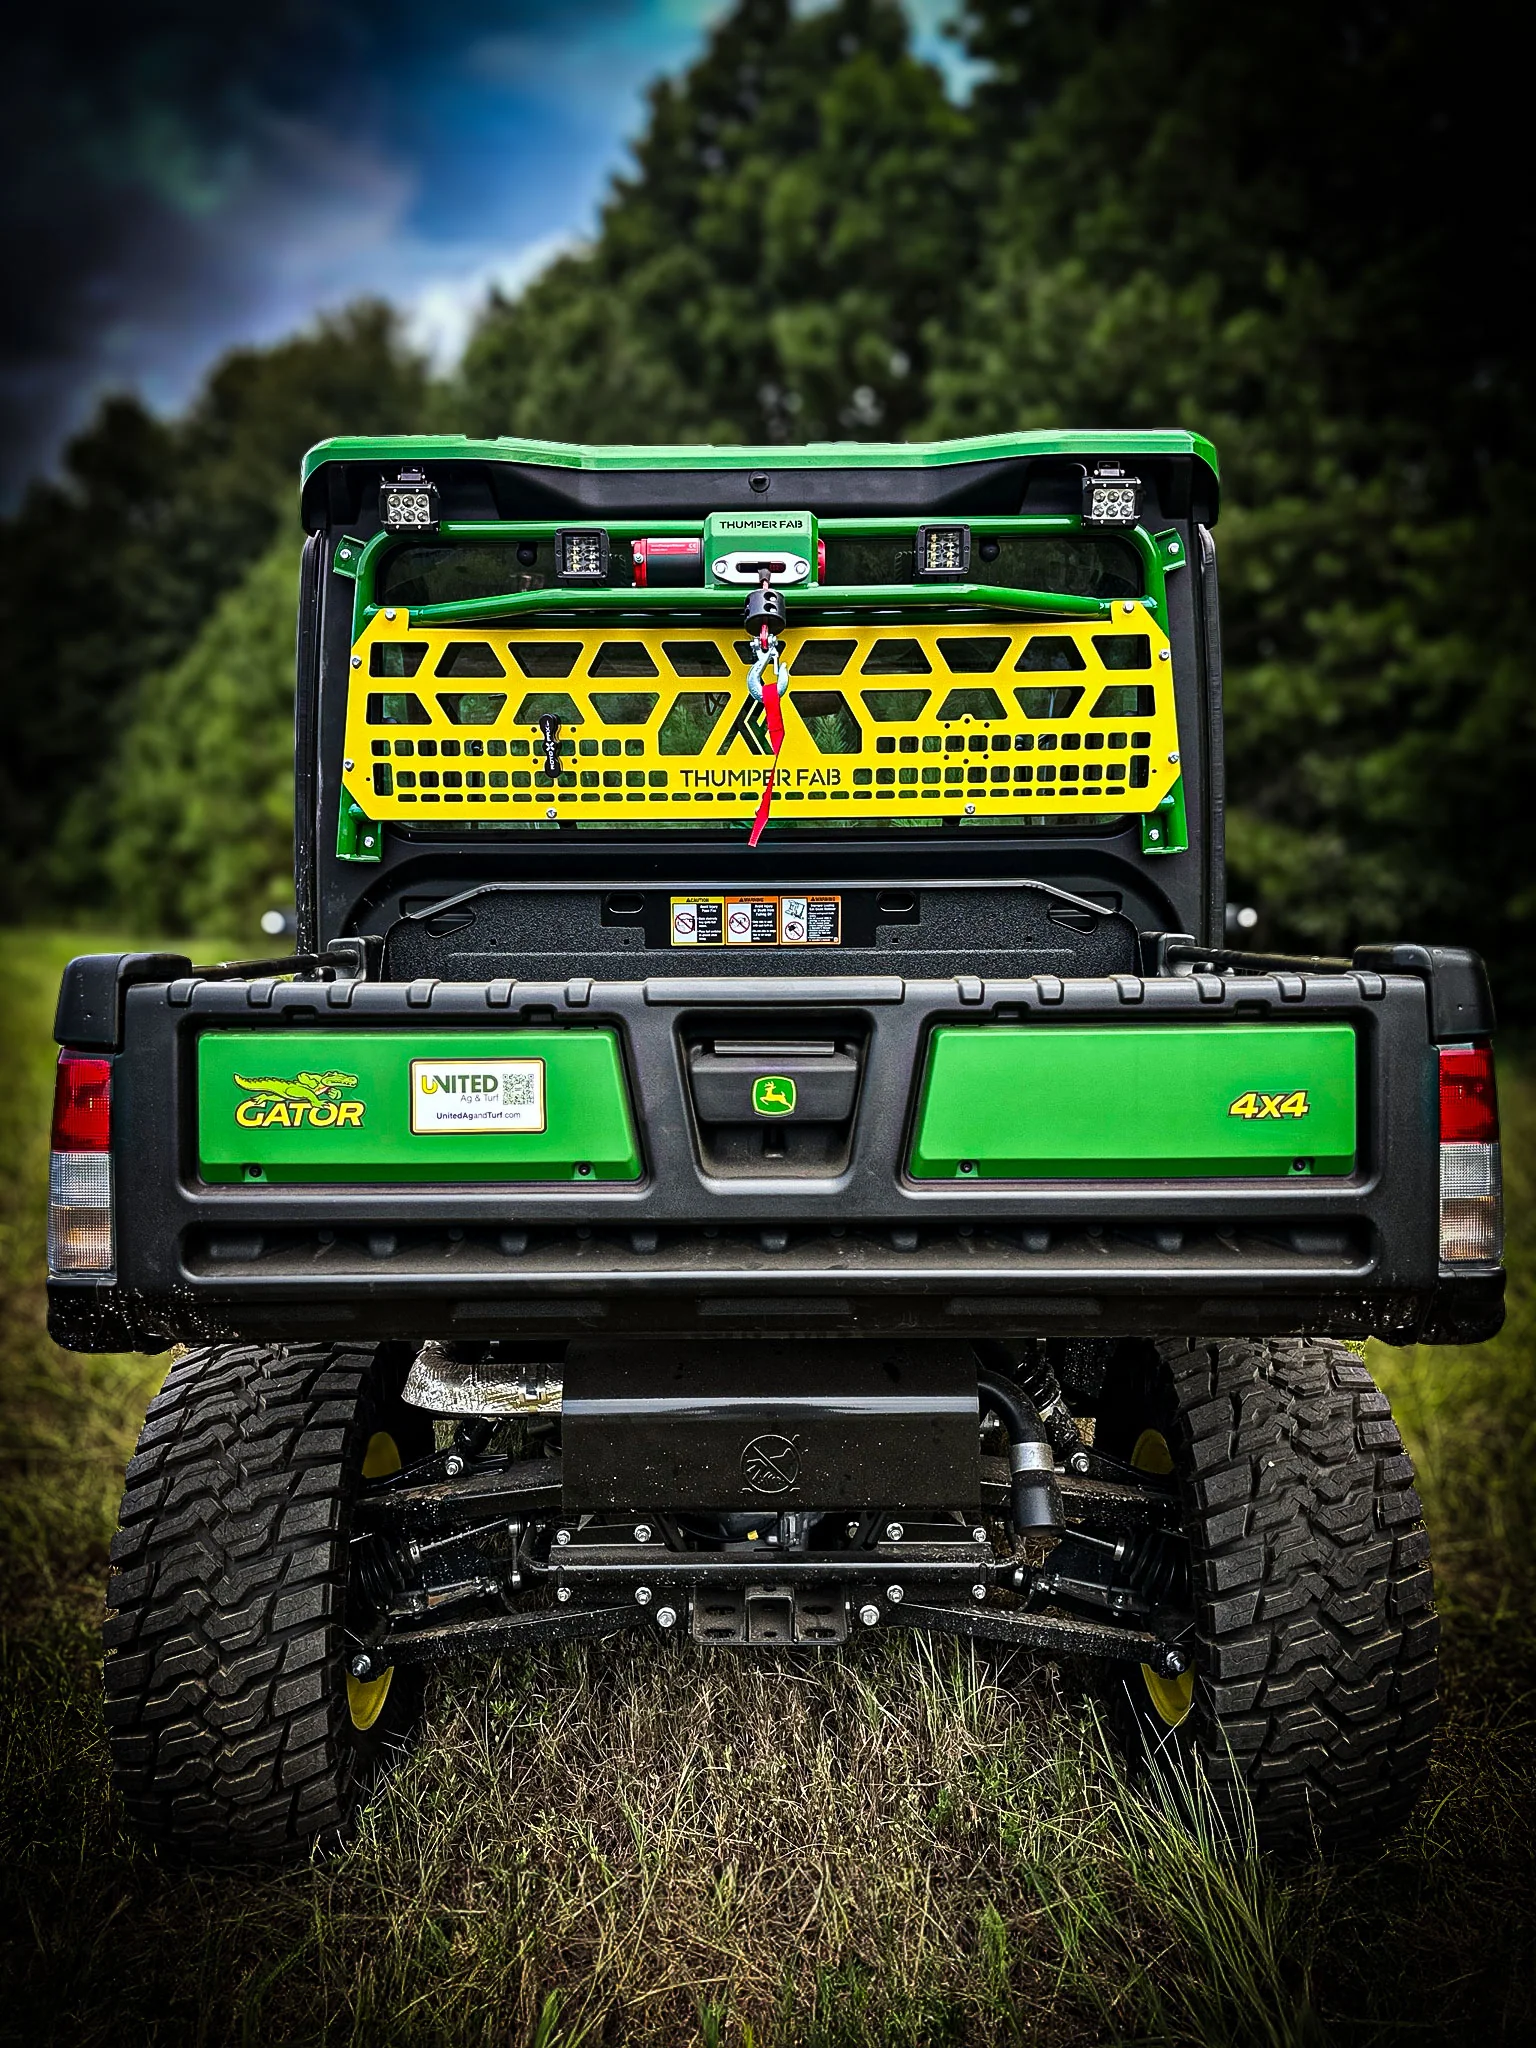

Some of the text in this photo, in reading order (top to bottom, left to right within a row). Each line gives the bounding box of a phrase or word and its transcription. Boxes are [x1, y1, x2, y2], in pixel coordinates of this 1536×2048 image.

[719, 520, 803, 529] THUMPER FAB
[679, 768, 841, 787] THUMPER FAB
[421, 1074, 499, 1095] UNITED
[460, 1093, 499, 1103] Ag & Turf
[235, 1099, 365, 1127] GATOR
[436, 1111, 521, 1120] UnitedAgandTurf.com
